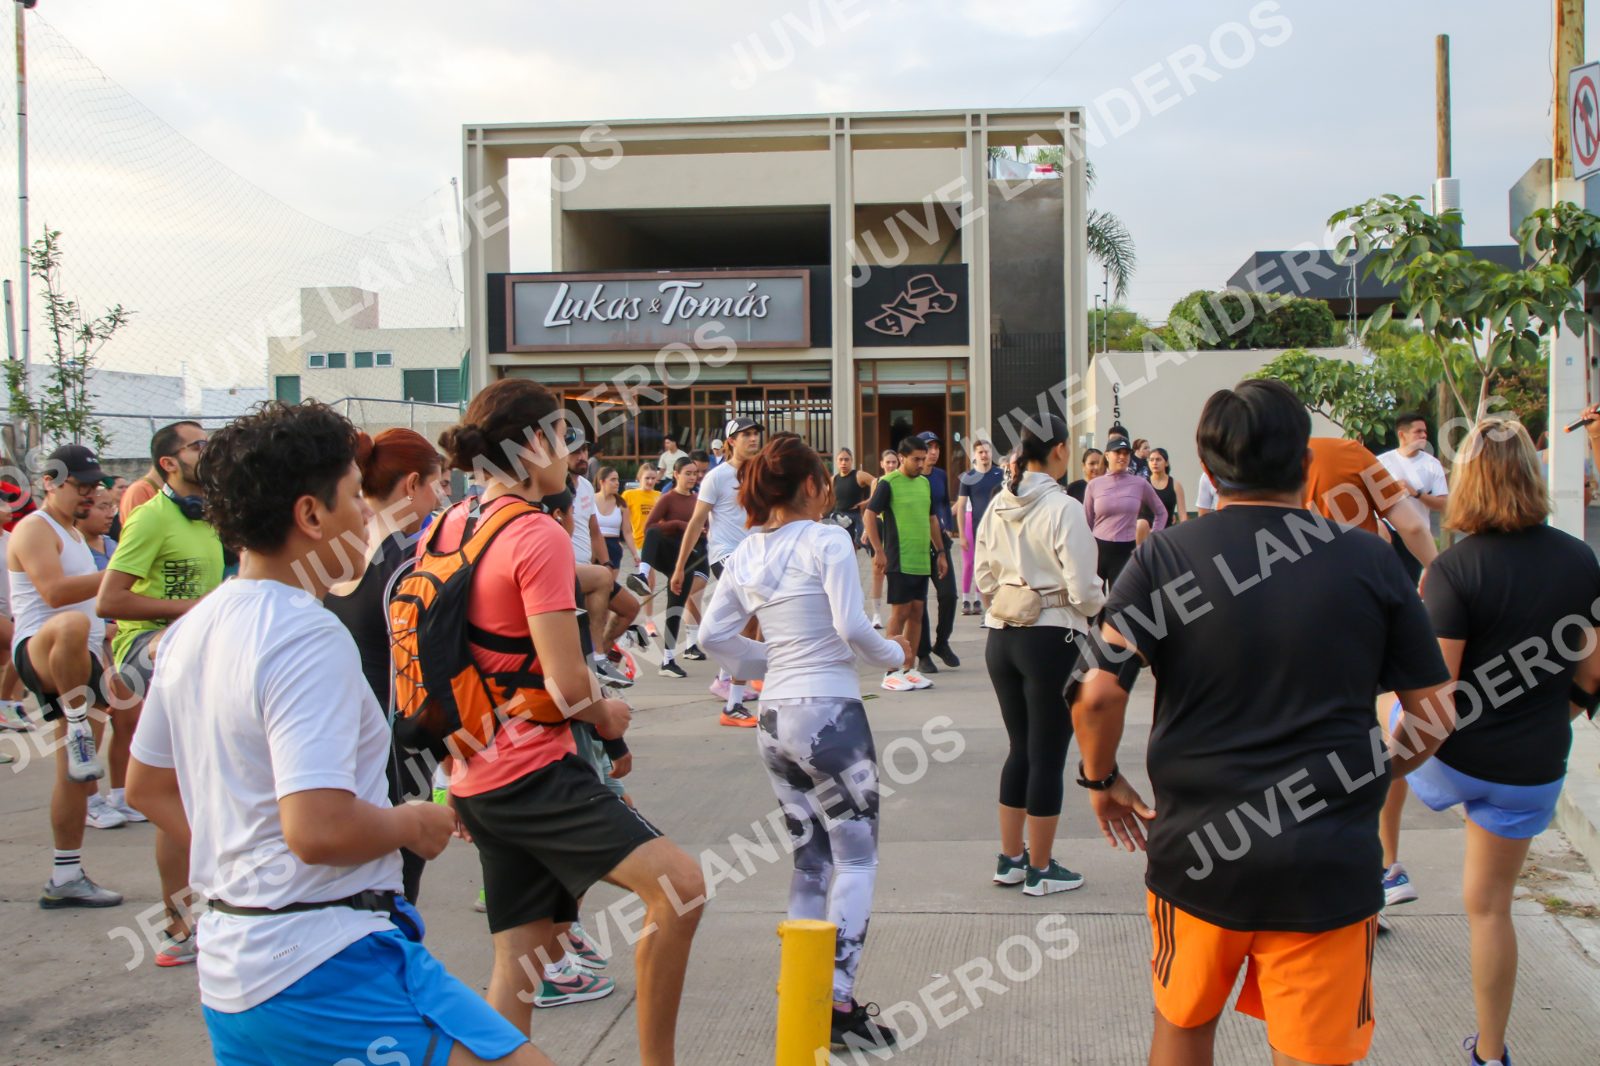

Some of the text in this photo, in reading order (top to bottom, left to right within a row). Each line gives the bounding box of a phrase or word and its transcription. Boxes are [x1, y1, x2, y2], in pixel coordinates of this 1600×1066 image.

[544, 280, 771, 327] Lukas & Tomás
